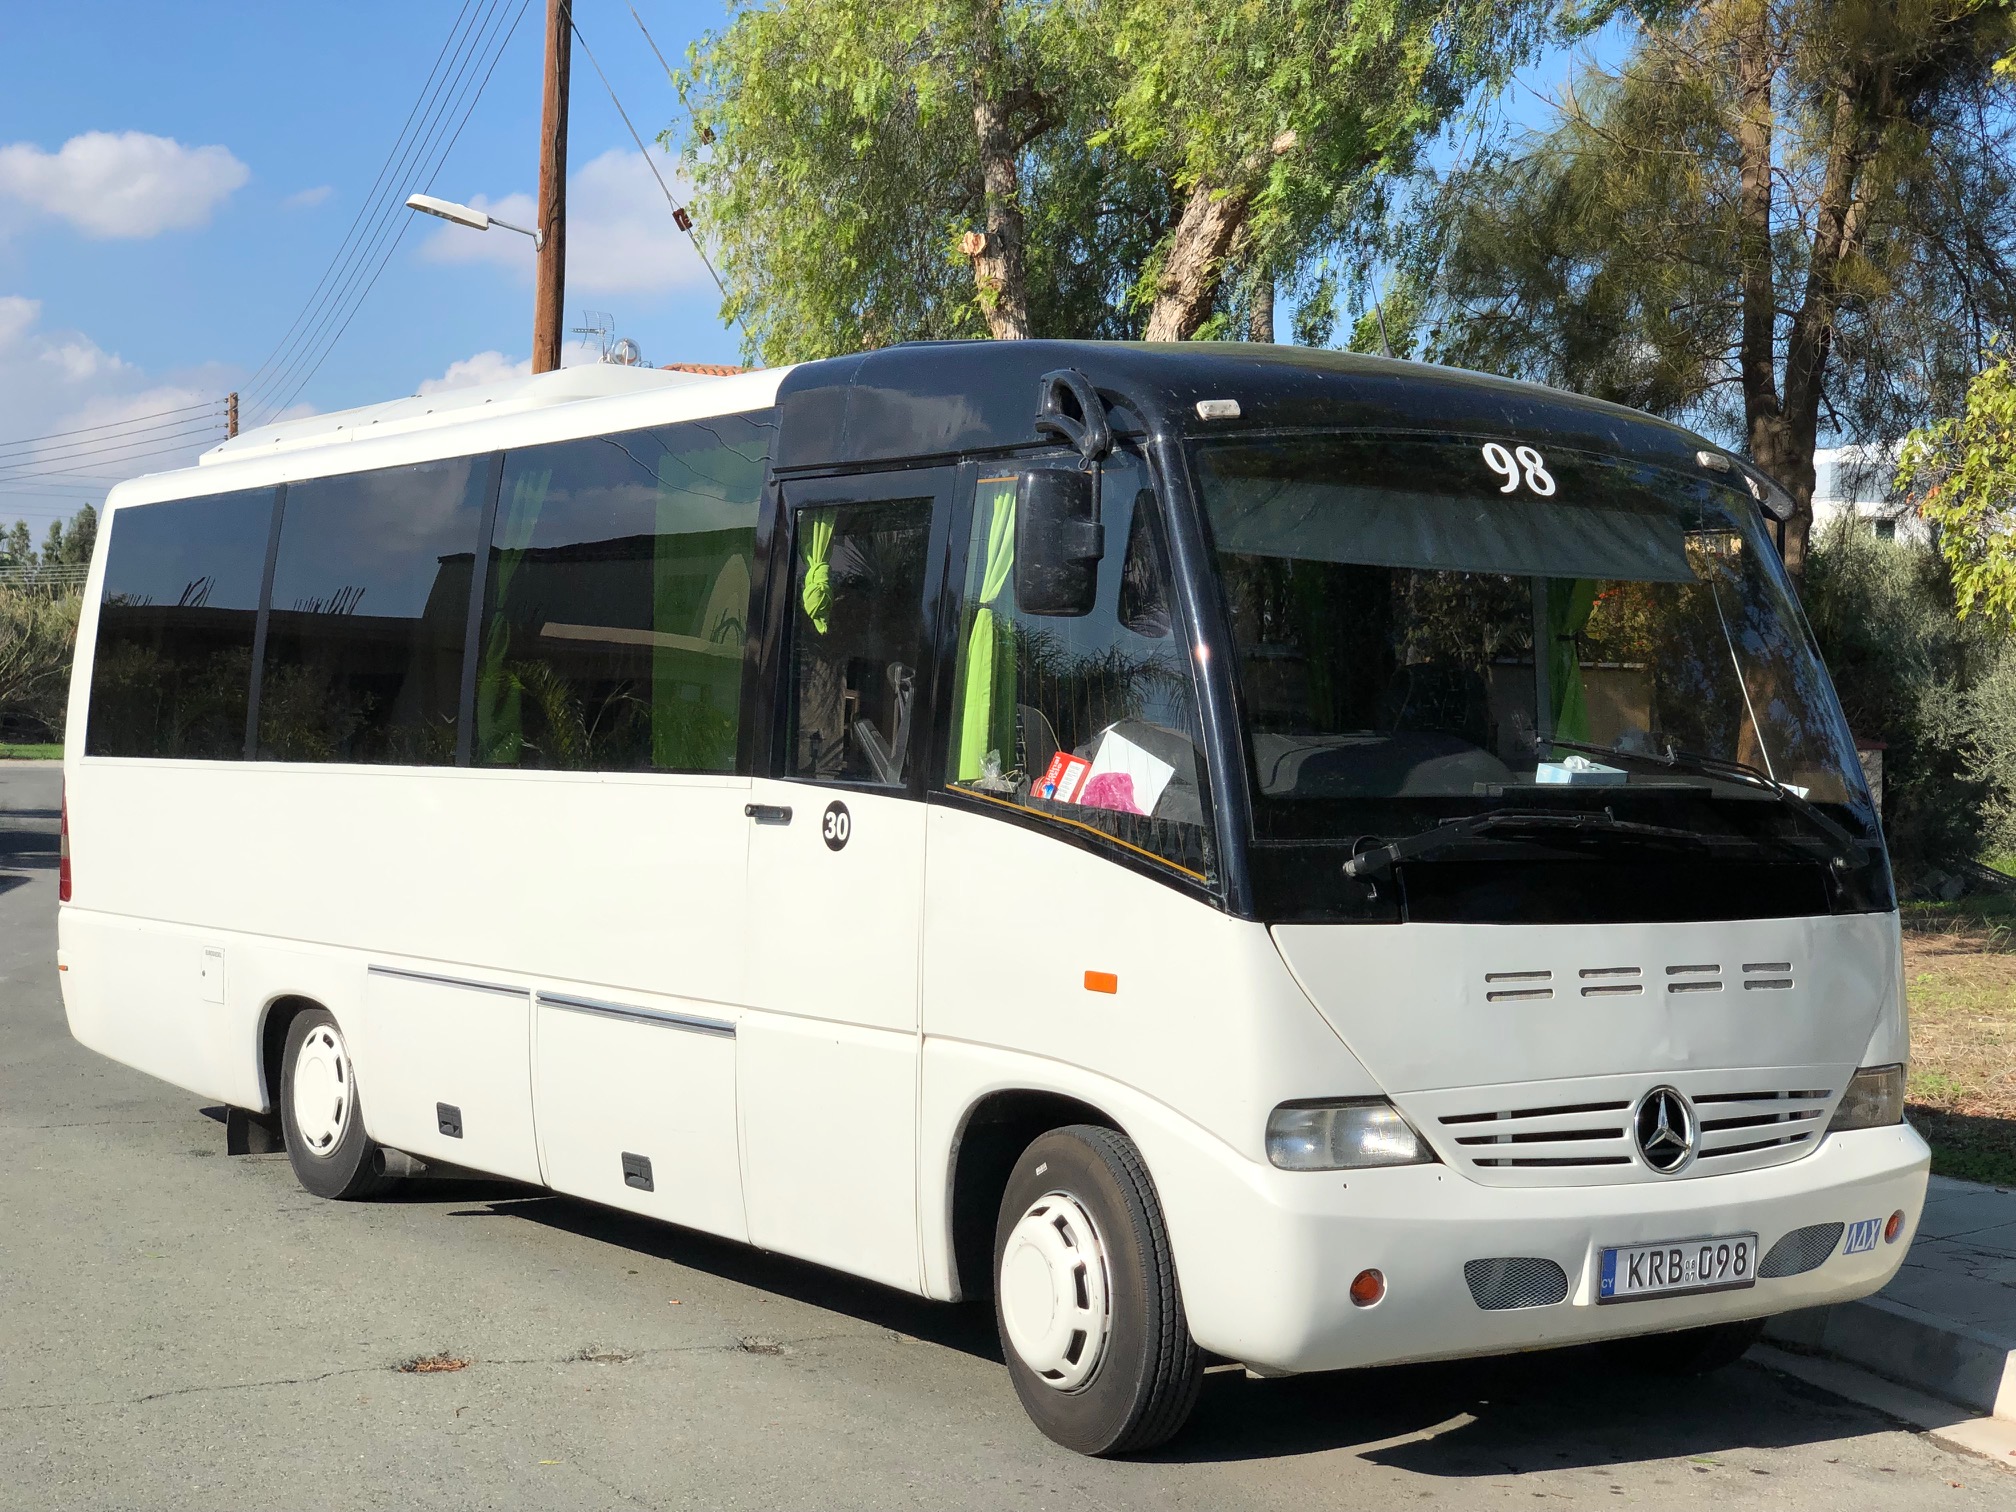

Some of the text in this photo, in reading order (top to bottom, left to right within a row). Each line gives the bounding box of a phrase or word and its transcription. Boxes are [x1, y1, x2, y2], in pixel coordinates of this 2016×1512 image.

[1482, 443, 1556, 496] 98
[825, 811, 849, 840] 30
[1601, 1278, 1614, 1289] CY
[1628, 1242, 1747, 1288] KRB 098
